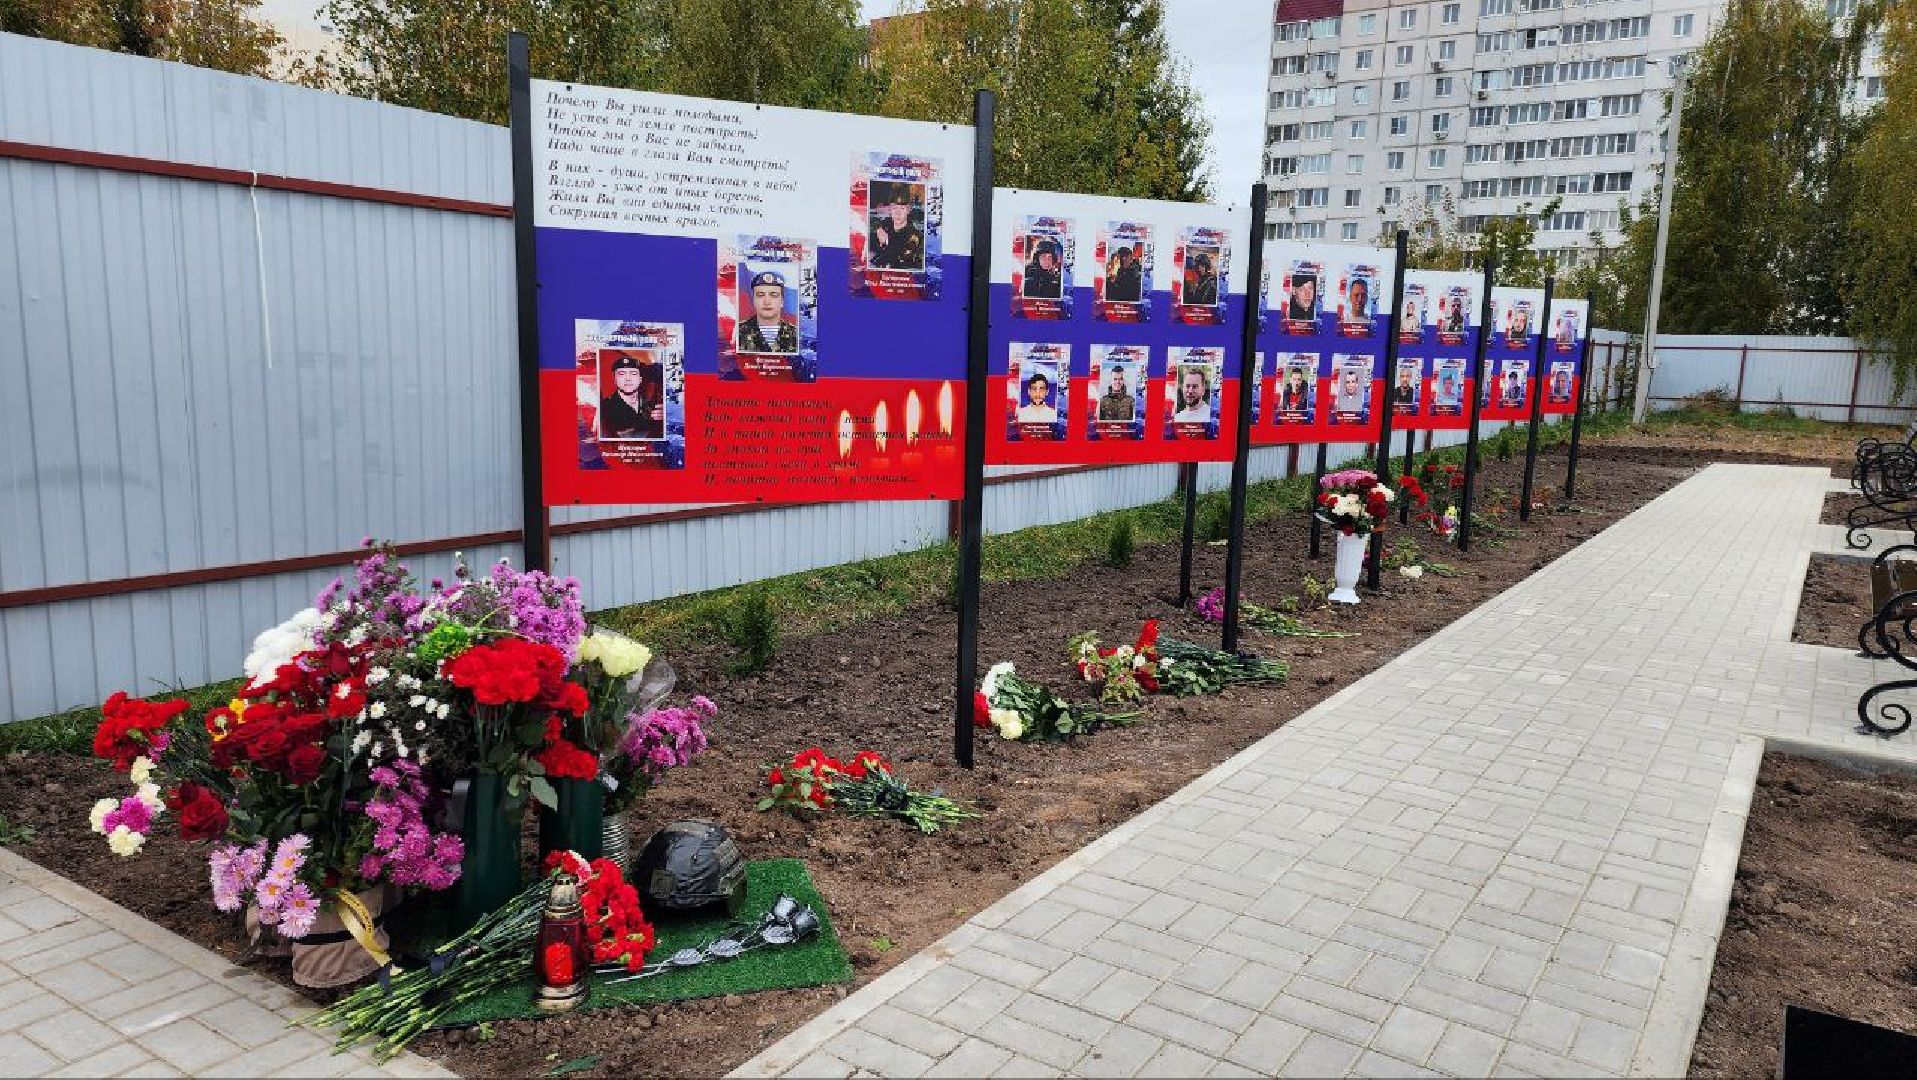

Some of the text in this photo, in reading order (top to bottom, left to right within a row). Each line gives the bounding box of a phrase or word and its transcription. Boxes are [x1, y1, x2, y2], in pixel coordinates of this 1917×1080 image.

[546, 92, 598, 110] Почему
[606, 98, 624, 110] Вы
[547, 107, 567, 120] Не
[616, 118, 633, 128] на
[640, 119, 676, 131] земле
[548, 122, 597, 138] Чтобы
[646, 133, 669, 145] Вас
[676, 139, 691, 147] не
[548, 138, 583, 152] Надо
[687, 151, 713, 164] Вам
[549, 160, 558, 171] В
[597, 193, 616, 206] Вы
